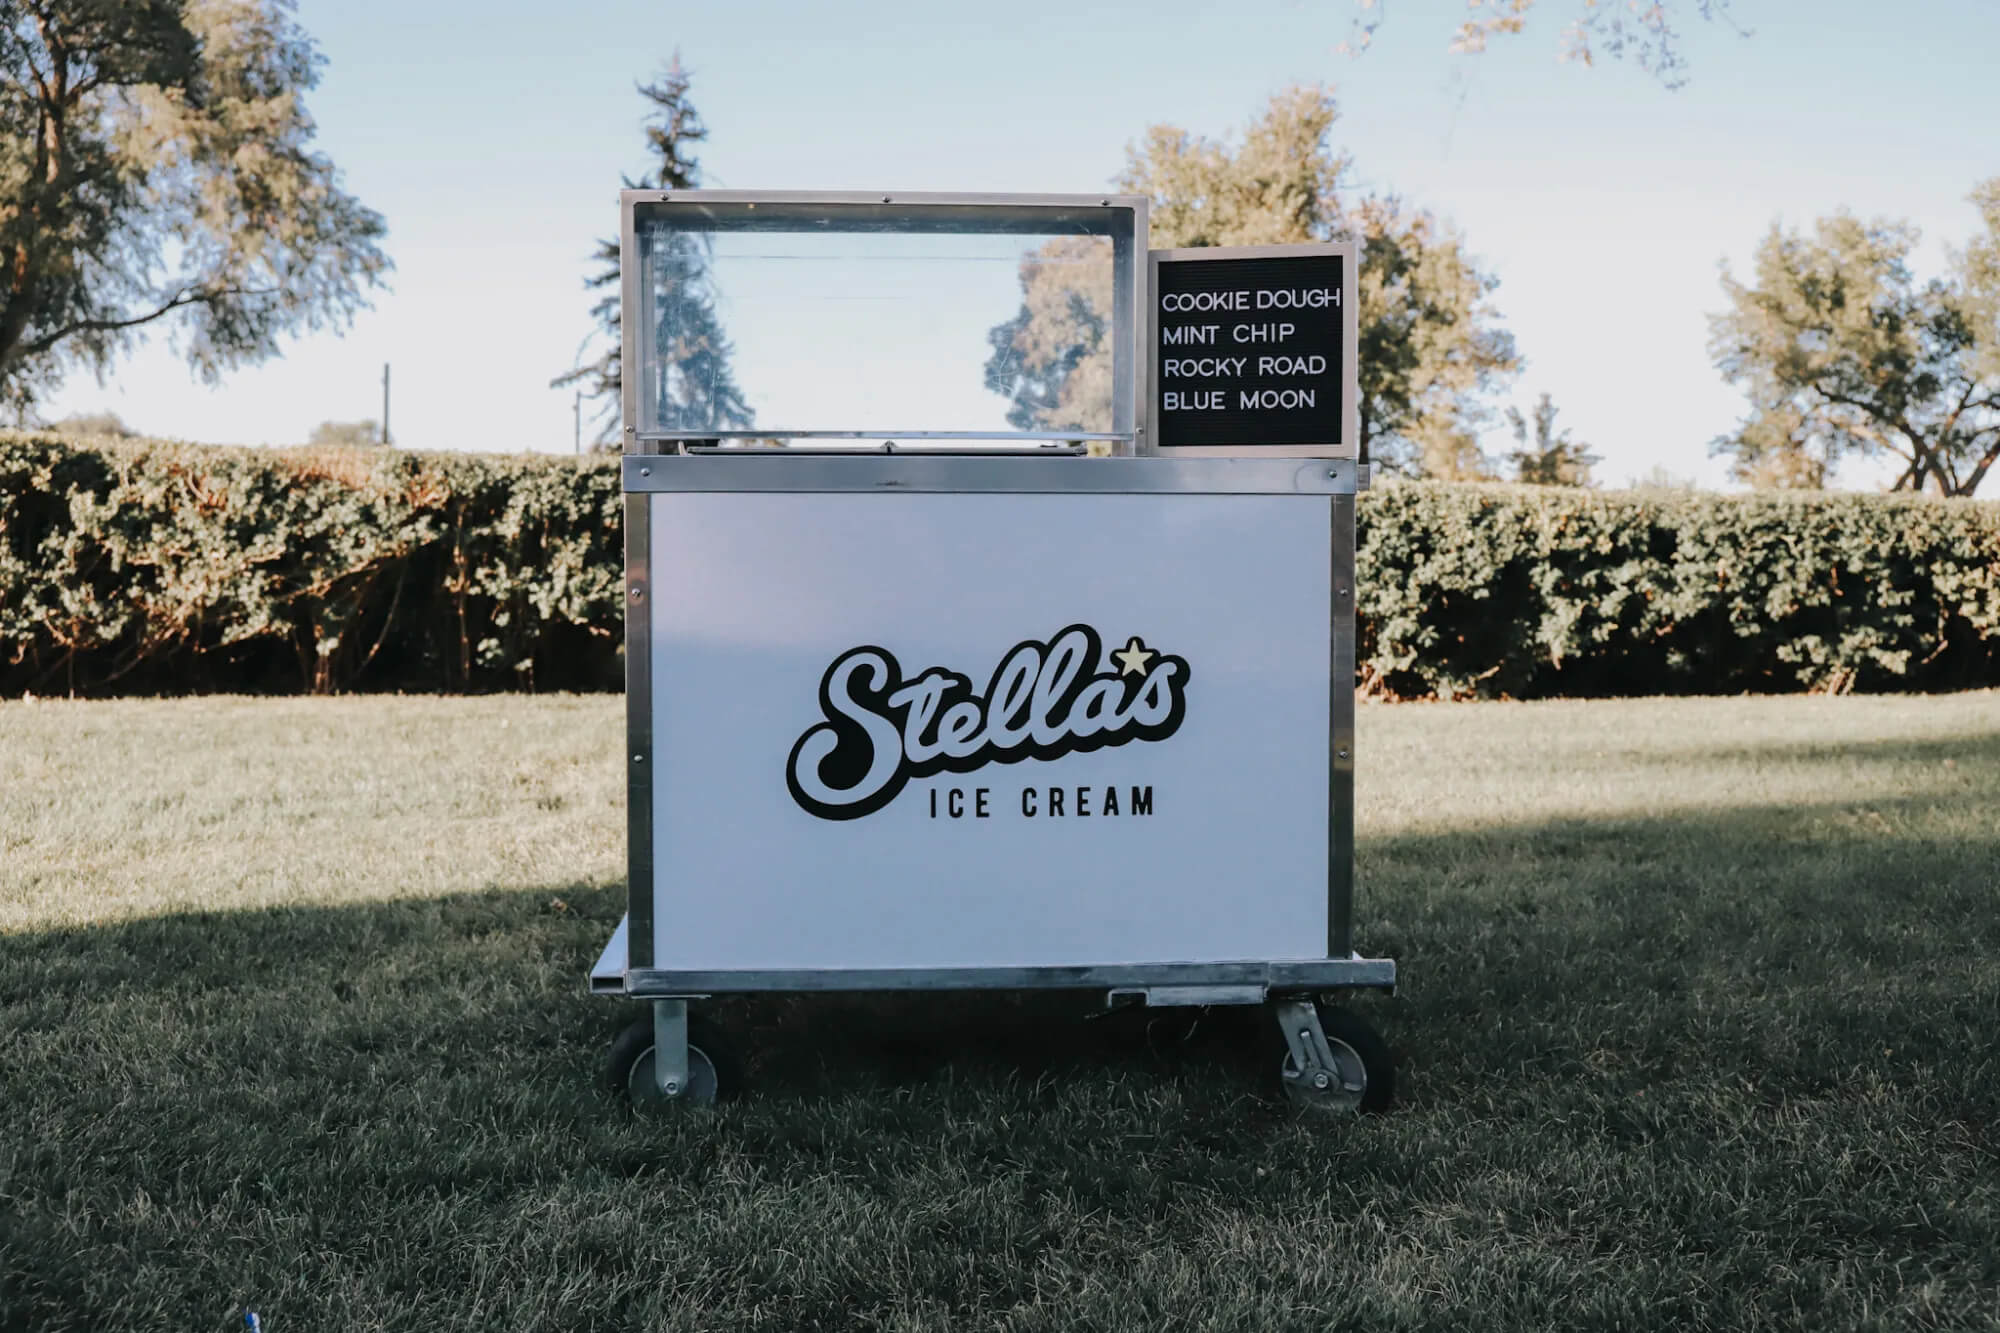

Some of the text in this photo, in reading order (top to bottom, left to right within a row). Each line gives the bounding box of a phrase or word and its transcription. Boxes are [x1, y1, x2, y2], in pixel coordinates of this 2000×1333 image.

[1162, 287, 1340, 311] COOKIE DOUGH
[1163, 323, 1294, 344] MINT CHIP
[1164, 355, 1326, 377] ROCKY ROAD
[1163, 389, 1314, 410] BLUE MOON
[930, 786, 1152, 818] ICE CREAM
